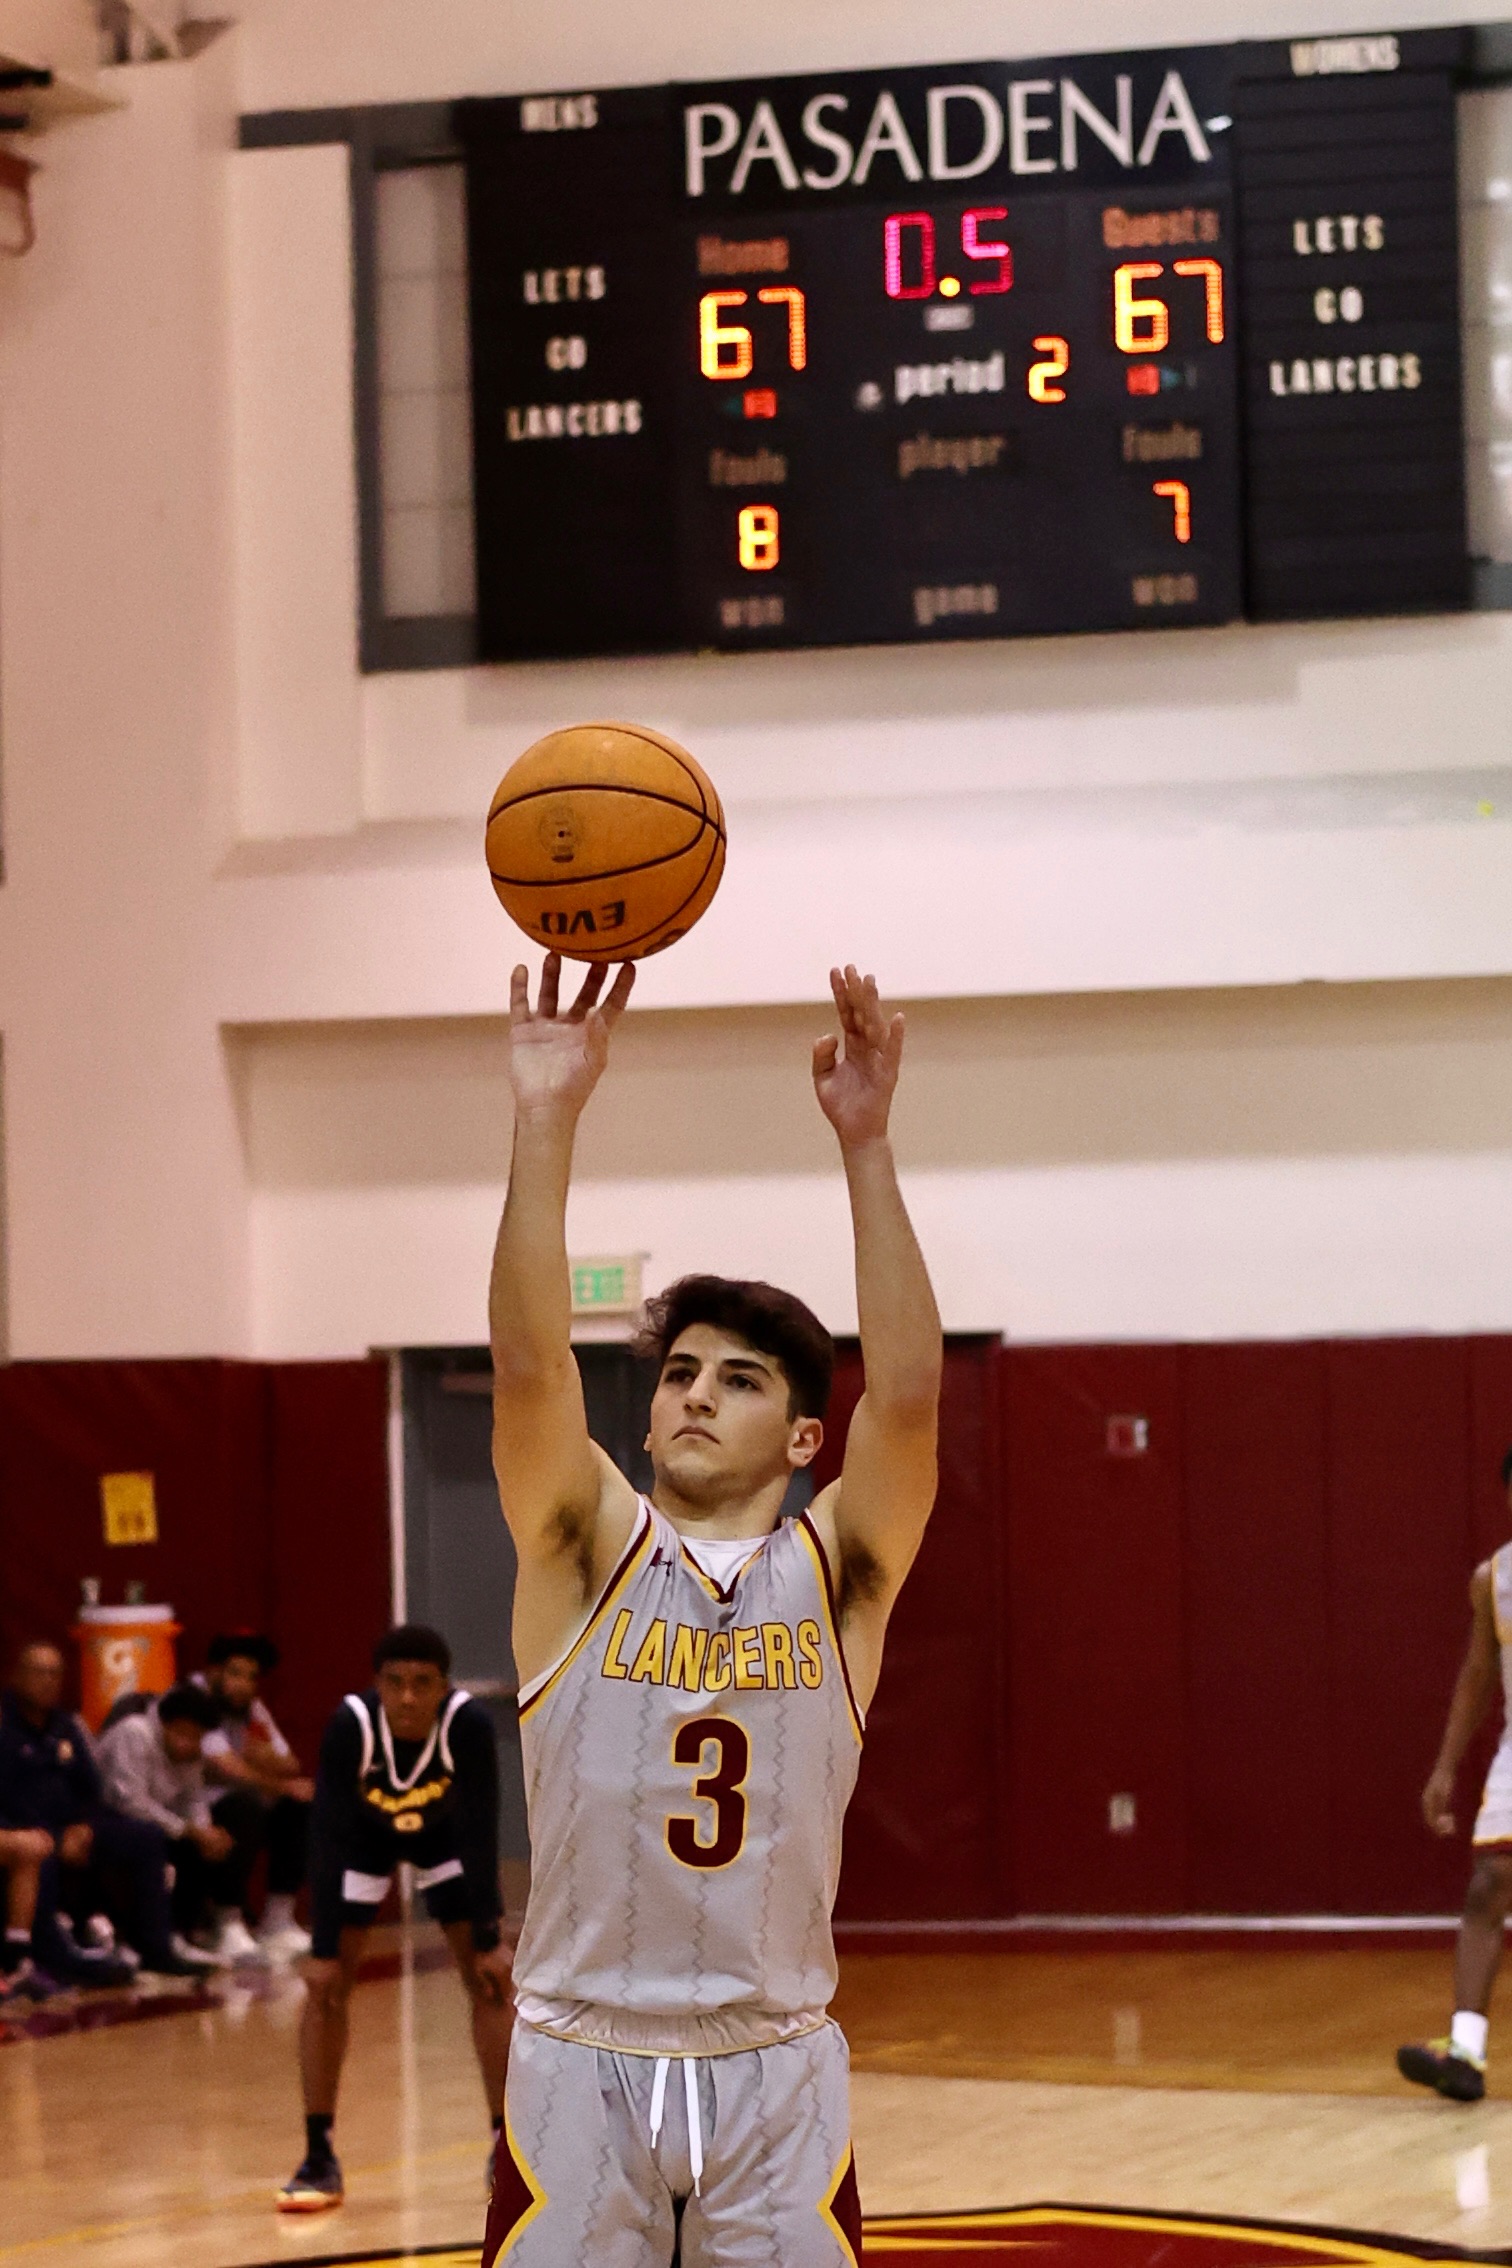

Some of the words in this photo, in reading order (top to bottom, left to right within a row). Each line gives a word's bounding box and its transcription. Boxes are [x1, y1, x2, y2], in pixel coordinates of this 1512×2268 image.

[684, 71, 1212, 196] PASADENA
[885, 208, 1013, 299] 0.5
[1292, 215, 1384, 253] LETS
[522, 267, 605, 303] LETS
[1113, 259, 1224, 353] 67
[700, 287, 805, 380] 67
[1028, 336, 1068, 403] 2
[1270, 353, 1421, 395] LANCERS
[506, 399, 642, 440] LANCERS
[739, 506, 779, 570] 8
[1153, 480, 1191, 543] 7
[540, 900, 625, 936] EVO
[600, 1608, 824, 1693] LANCERS
[664, 1714, 750, 1871] 3
